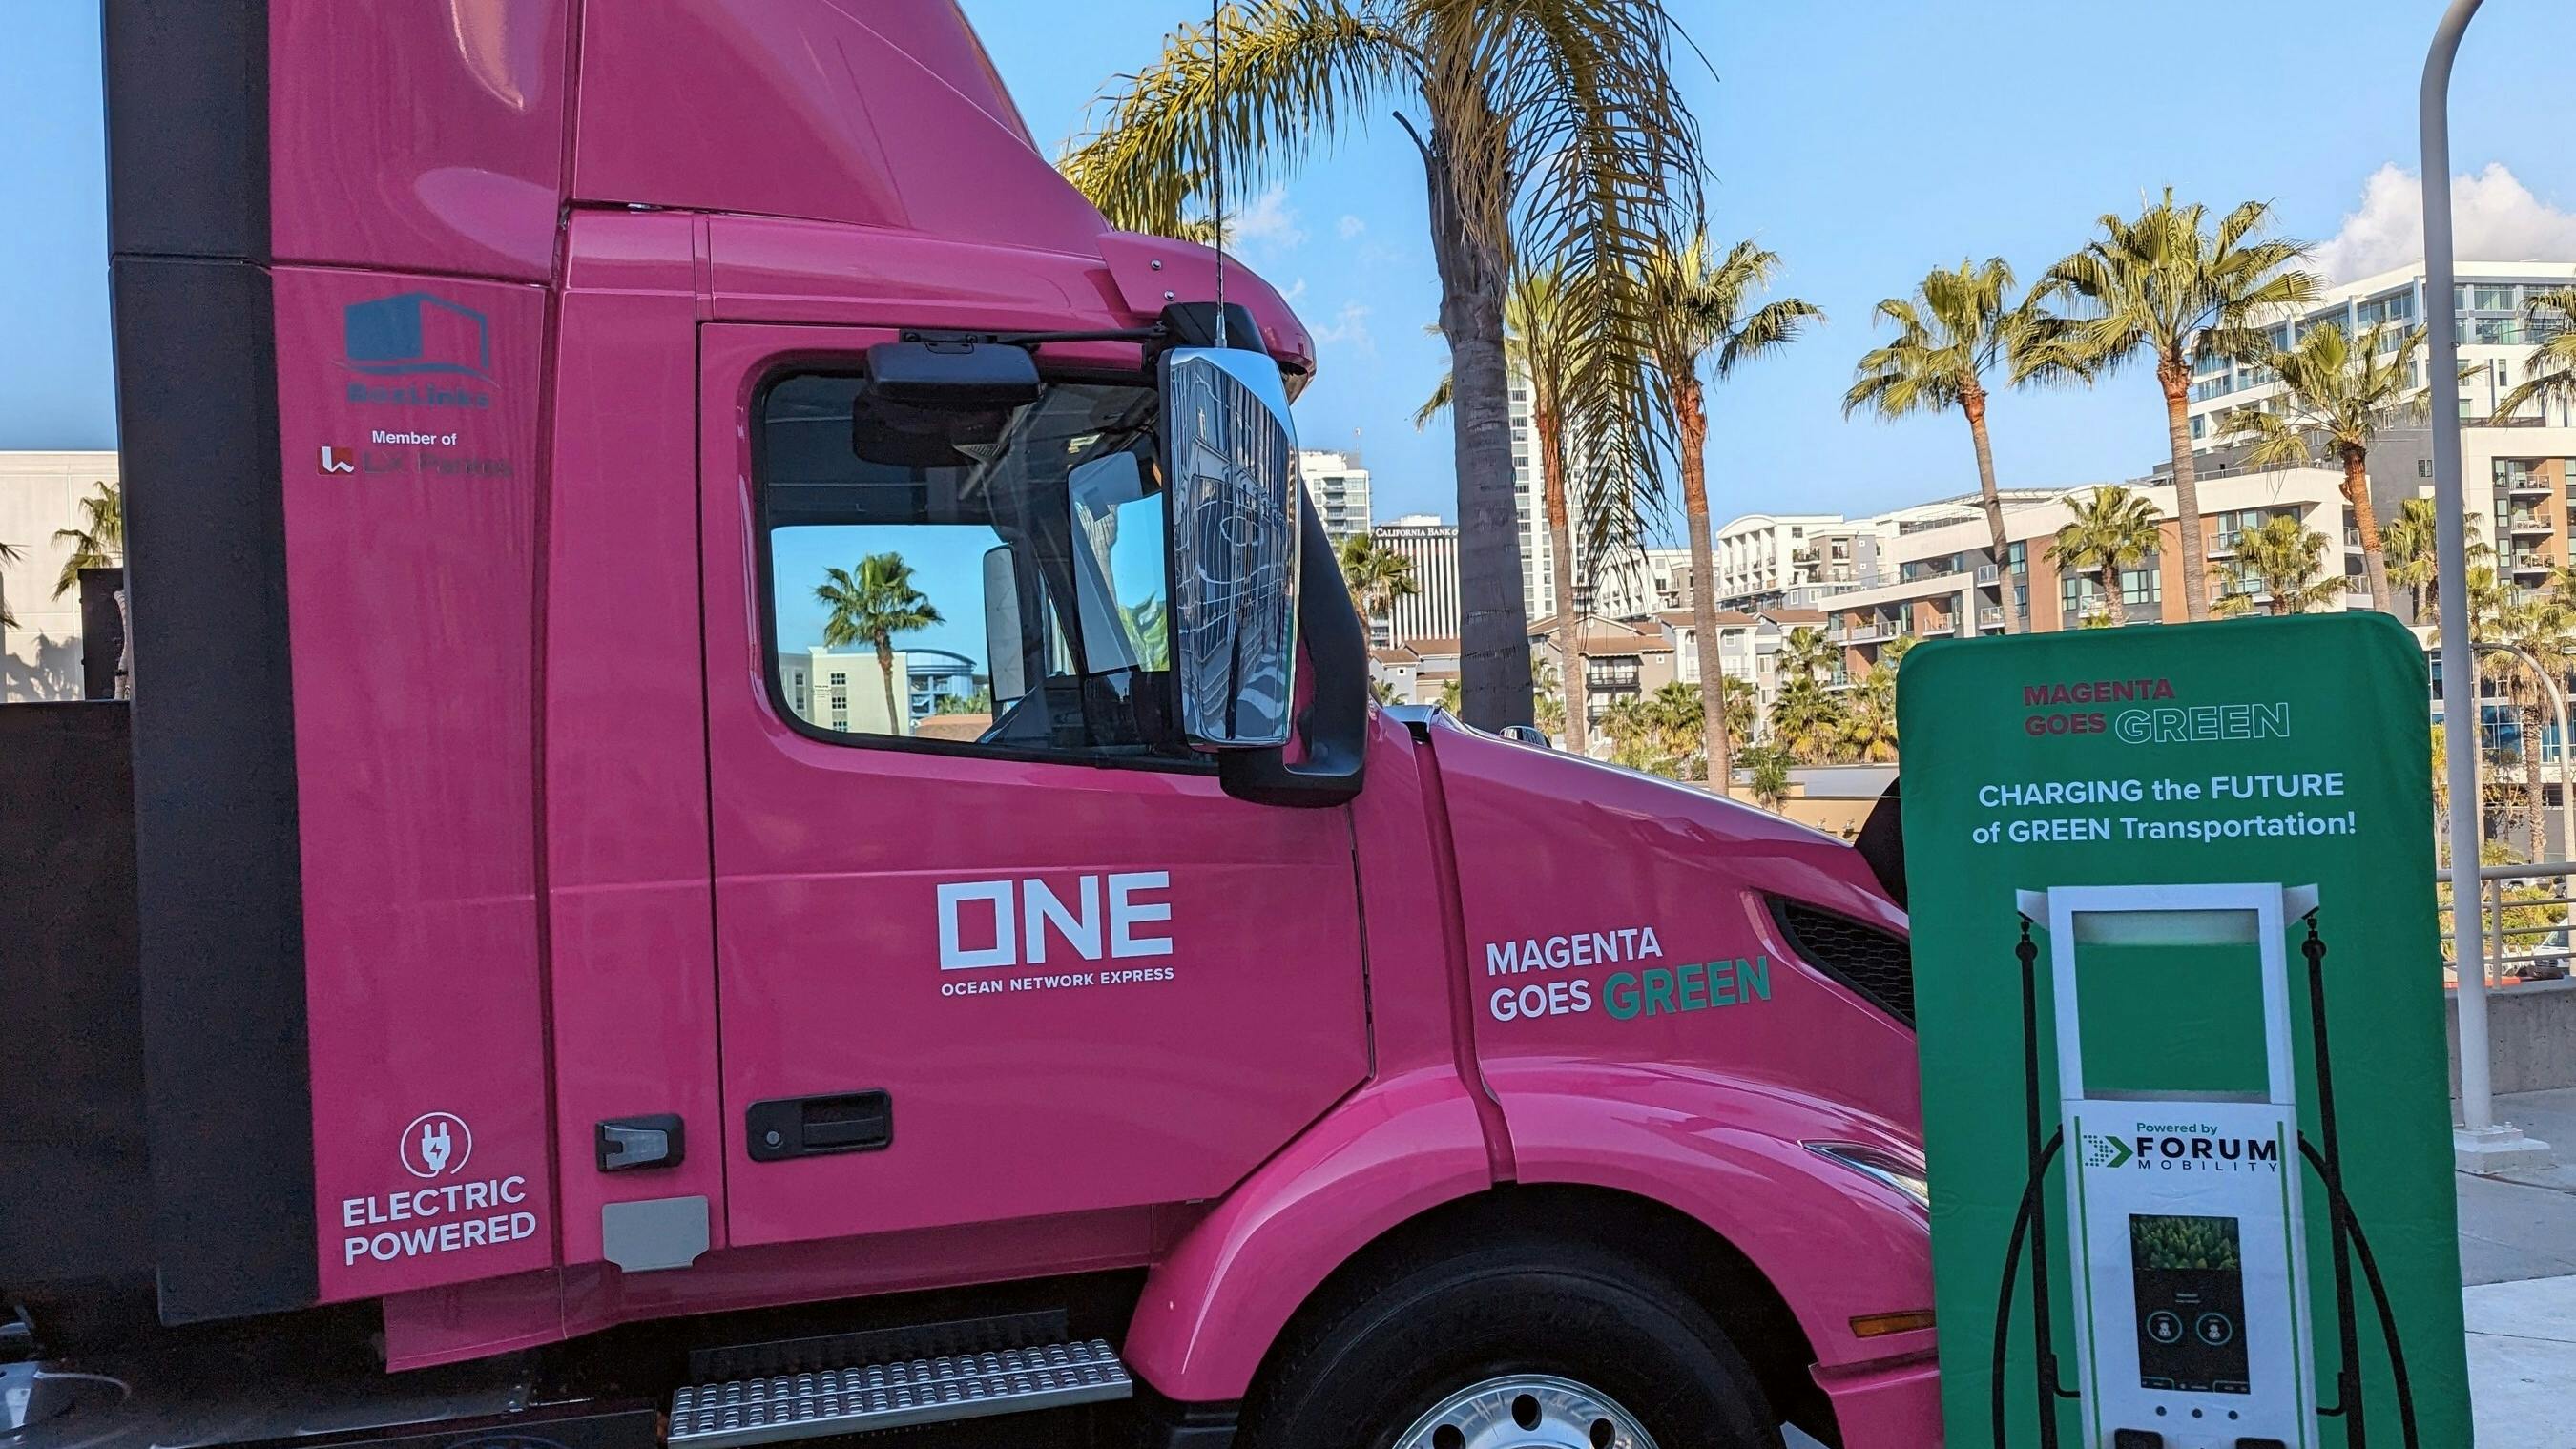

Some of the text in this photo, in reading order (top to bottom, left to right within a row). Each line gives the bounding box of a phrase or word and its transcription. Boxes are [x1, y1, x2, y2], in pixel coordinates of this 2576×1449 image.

[372, 430, 458, 446] Member of
[1375, 528, 1426, 537] CALIFORNIA
[1427, 527, 1451, 536] BANK
[2024, 678, 2175, 706] MAGENTA
[2025, 702, 2290, 744] GOES GREEN
[1979, 772, 2344, 807] CHARGING the FUTURE
[1972, 810, 2357, 844] of GREEN Transportation!
[937, 870, 1174, 970] ONE
[1485, 926, 1663, 976] MAGENTA
[941, 967, 1174, 997] OCEAN NETWORK EXPRESS
[1490, 955, 1772, 1022] GOES GREEN
[2136, 1122, 2218, 1135] Powered by
[2136, 1137, 2277, 1160] FORUM
[2138, 1159, 2278, 1172] MOBILITY
[343, 1175, 526, 1228] ELECTRIC
[344, 1211, 536, 1266] POWERED
